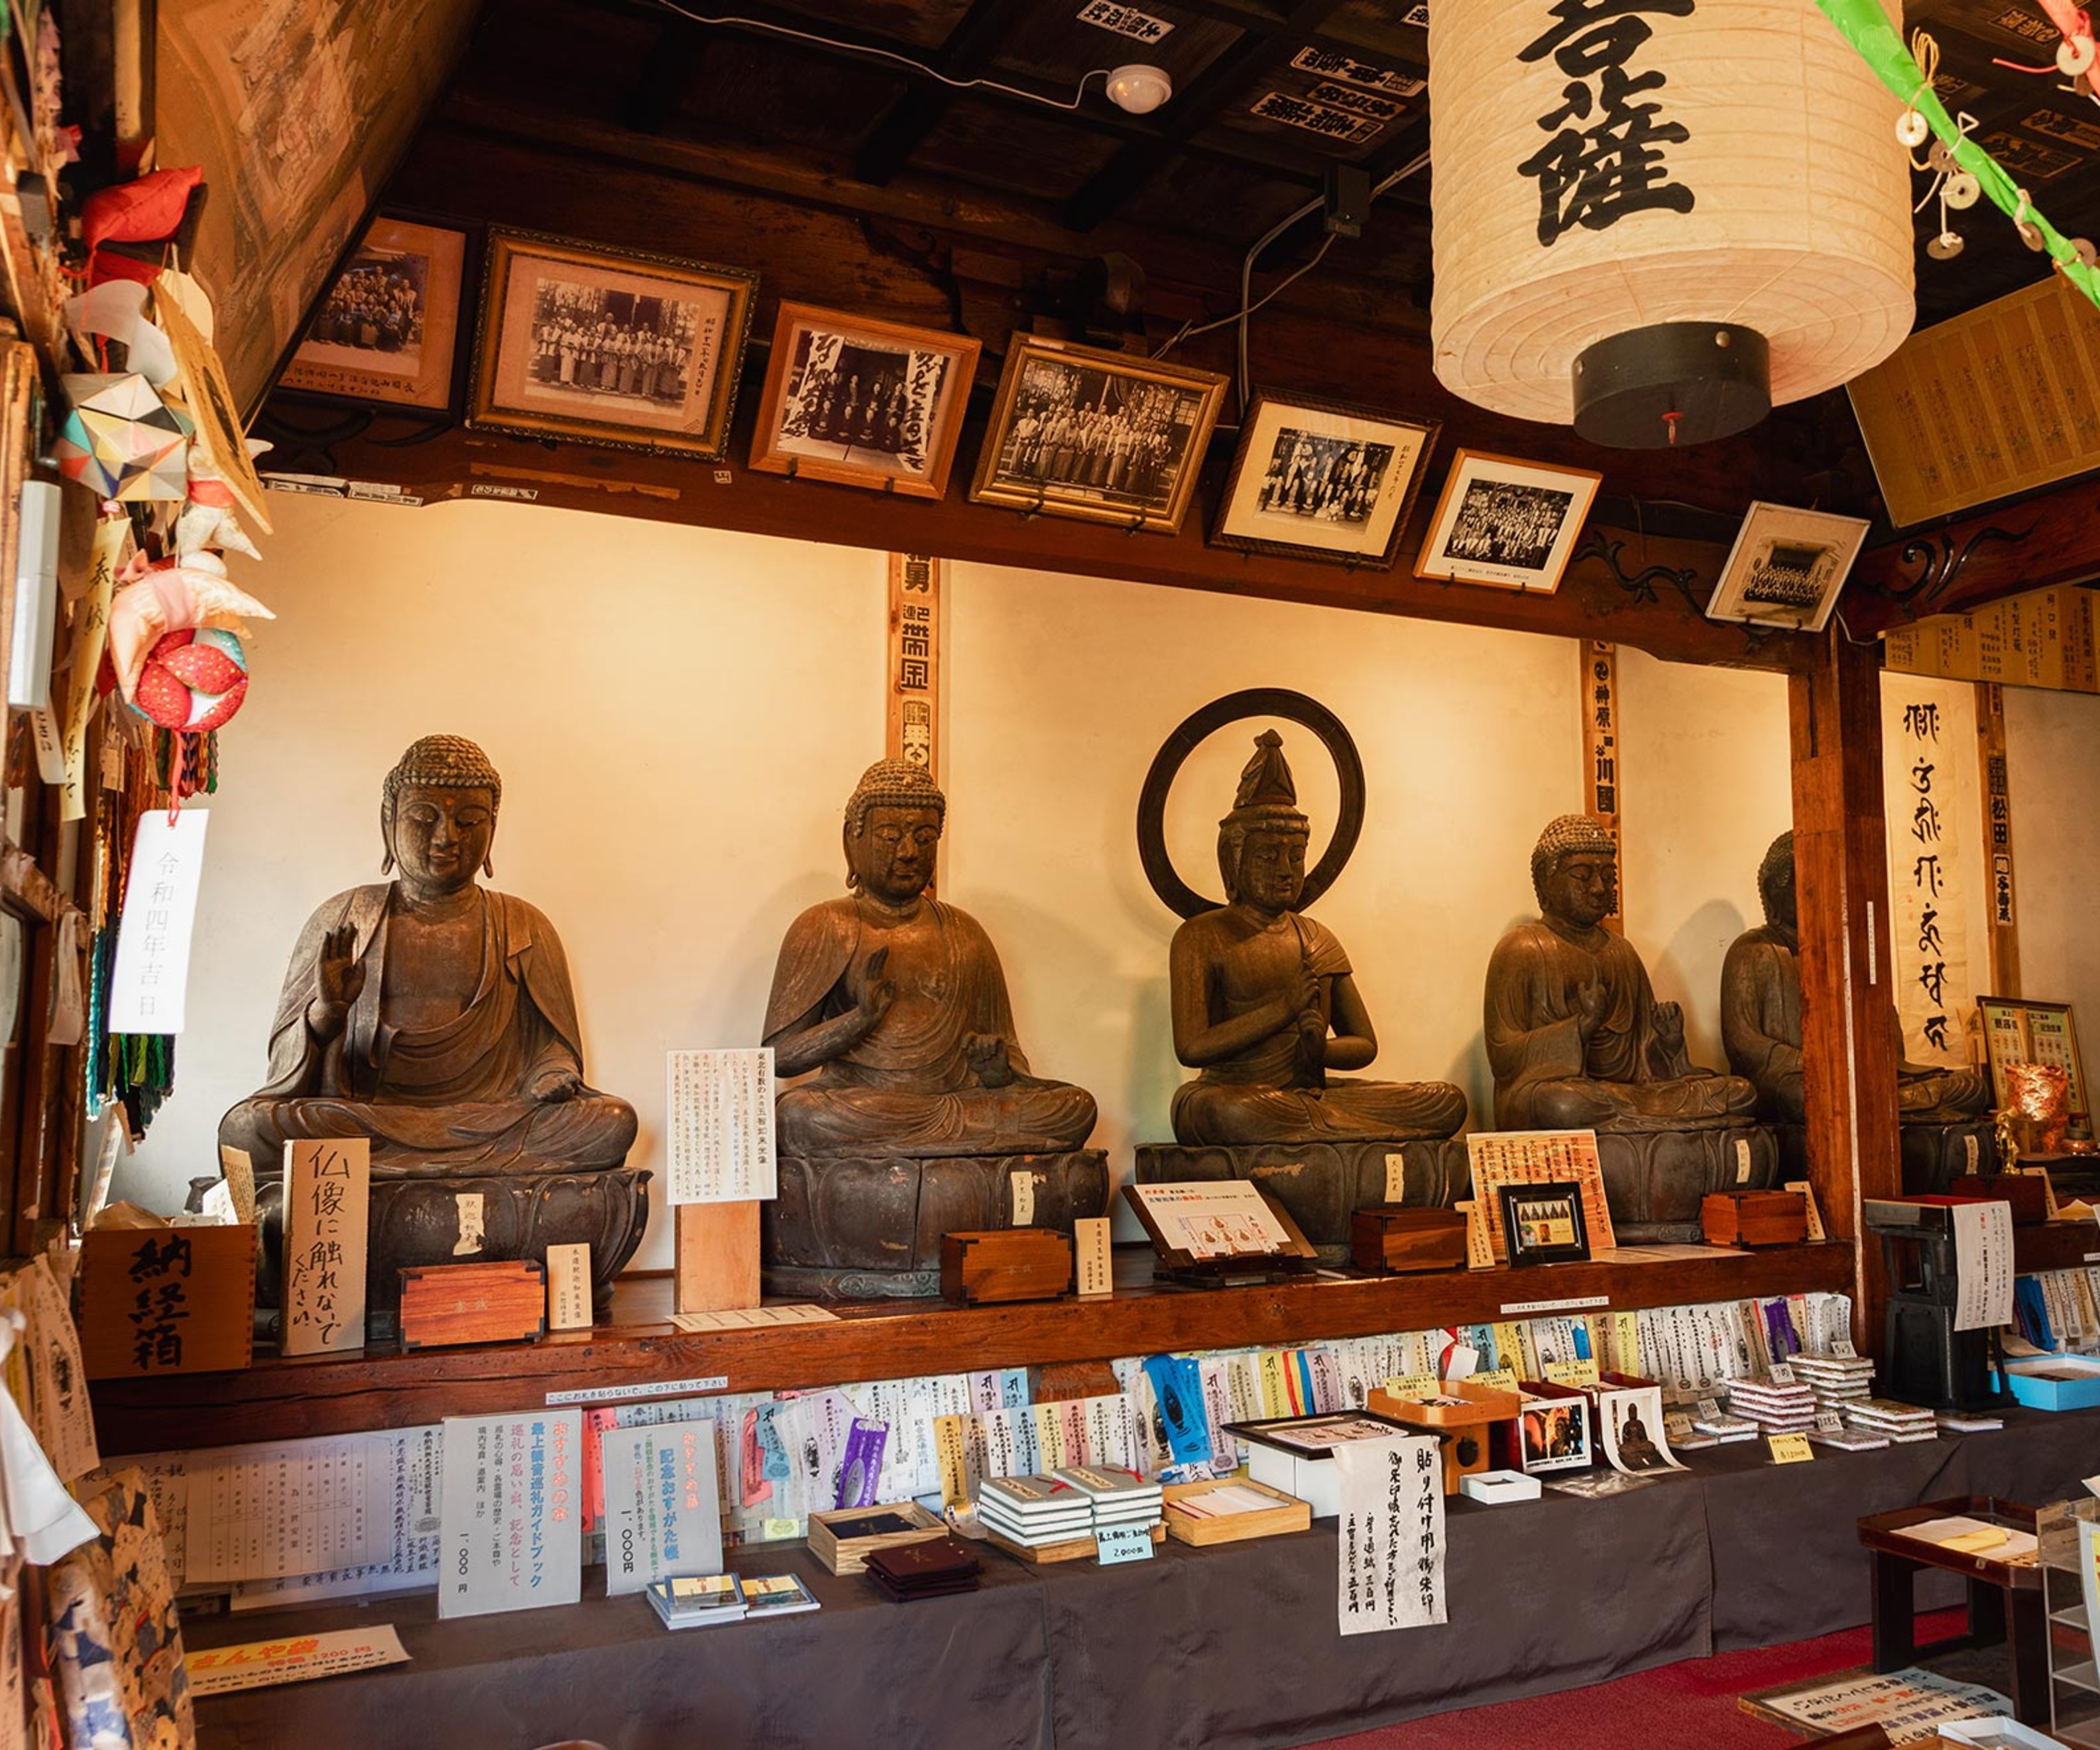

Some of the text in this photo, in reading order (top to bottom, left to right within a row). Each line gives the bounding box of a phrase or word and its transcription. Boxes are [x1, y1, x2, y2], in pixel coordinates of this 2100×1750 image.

[139, 852, 179, 1016] 令和四年吉日
[128, 1234, 192, 1370] 納経箱
[292, 1253, 312, 1326] ください
[309, 1145, 350, 1345] 仏像に触れないで
[530, 1422, 544, 1588] 最上観音巡礼ガイドブック
[552, 1421, 569, 1522] おすすめの本
[1417, 1448, 1434, 1615] 貼り付け用御朱印
